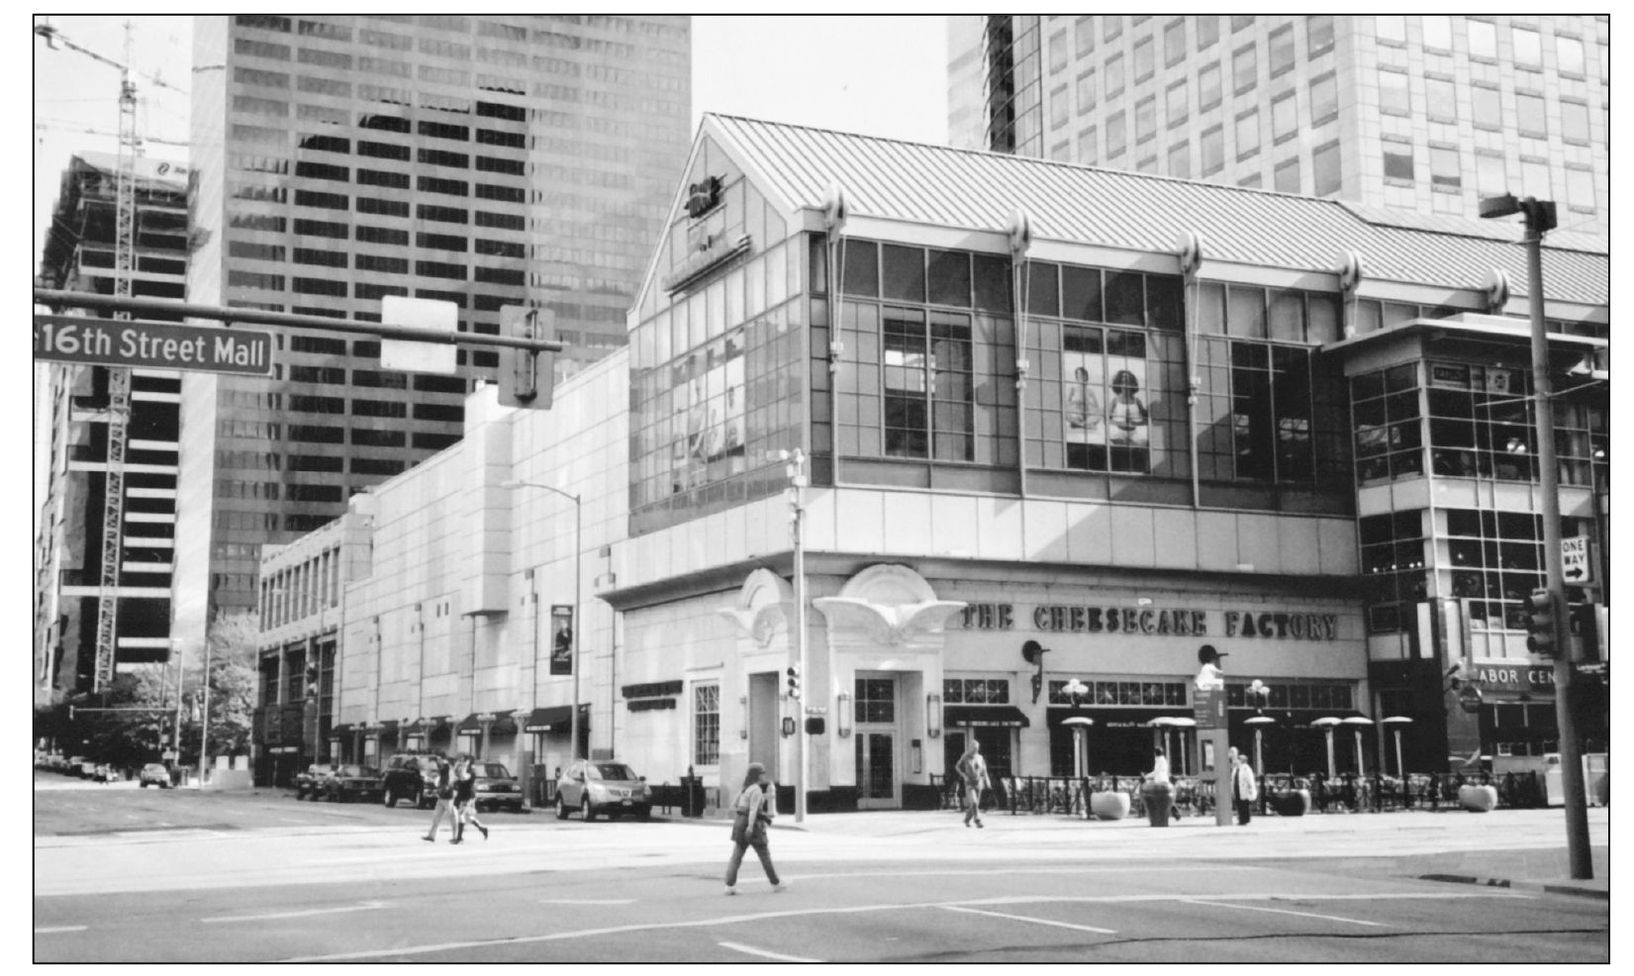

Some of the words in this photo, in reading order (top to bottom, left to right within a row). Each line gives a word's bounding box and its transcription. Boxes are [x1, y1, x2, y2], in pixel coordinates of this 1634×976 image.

[42, 323, 111, 355] 16th
[119, 328, 206, 363] Street
[214, 335, 264, 366] Mall
[1563, 539, 1583, 553] ONE
[1564, 553, 1585, 565] WAY
[960, 602, 1014, 630] THE
[1033, 605, 1208, 637] CHEESECAKE
[1224, 611, 1337, 642] FACTORY
[1473, 667, 1519, 684] ABOR
[1528, 669, 1556, 684] CEN
